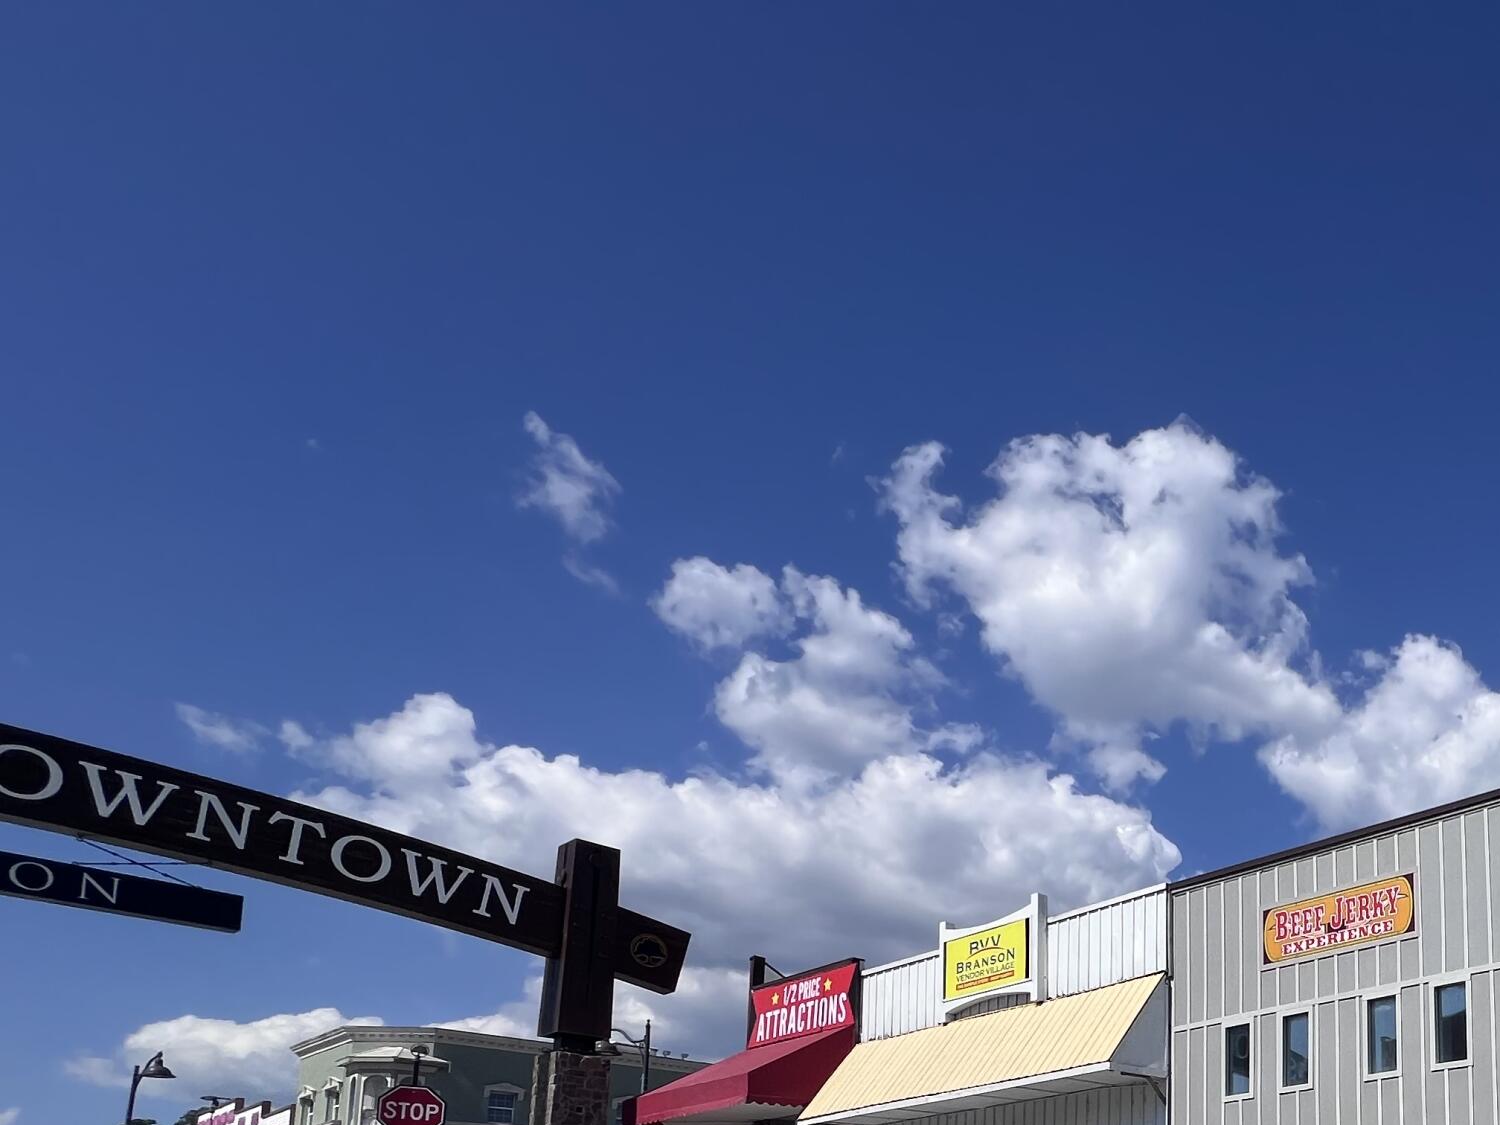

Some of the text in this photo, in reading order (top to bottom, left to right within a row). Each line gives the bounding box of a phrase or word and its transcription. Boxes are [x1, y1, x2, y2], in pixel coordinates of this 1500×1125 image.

[0, 744, 530, 925] OWNTOWN
[8, 861, 120, 904] ON
[1281, 920, 1394, 956] EXPERIENCE
[956, 947, 1015, 974] BRANSON
[956, 969, 985, 982] VENDOR
[985, 961, 1015, 975] VILLAGE
[783, 977, 821, 1006] 1/2 PRICE
[756, 992, 847, 1042] ATTRACTIONS
[383, 1101, 440, 1121] STOP
